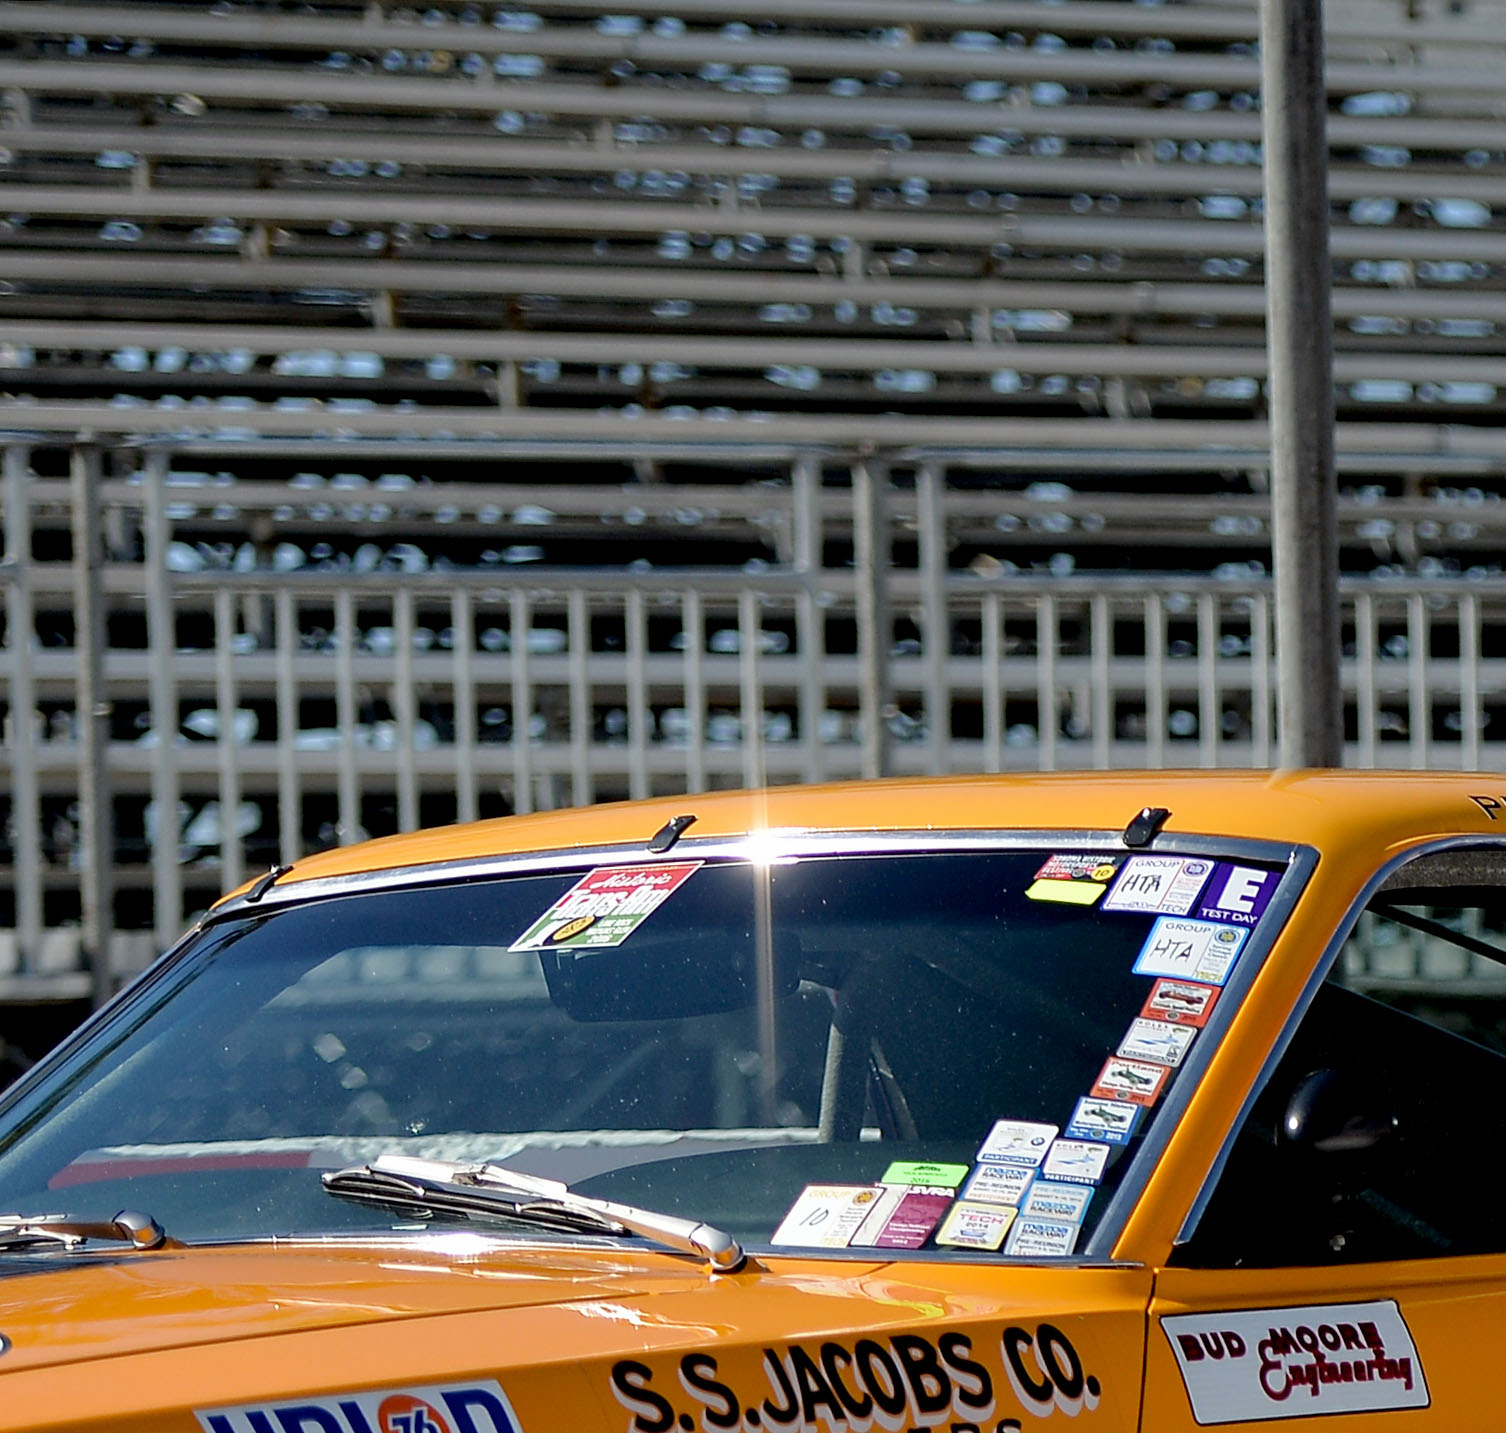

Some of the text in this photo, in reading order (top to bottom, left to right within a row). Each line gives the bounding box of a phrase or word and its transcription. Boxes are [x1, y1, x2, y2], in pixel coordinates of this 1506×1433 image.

[1135, 859, 1181, 869] GROUP
[590, 872, 673, 889] Historic
[1216, 866, 1268, 913] E
[1161, 903, 1188, 914] TECH
[1201, 908, 1258, 925] TEST DAY
[1165, 922, 1211, 934] GROUP
[1045, 1174, 1096, 1185] PARTICIPANT
[960, 1213, 1005, 1225] TECH
[1177, 1321, 1384, 1362] BUD MOORE
[1000, 1323, 1102, 1418] CO.
[1257, 1337, 1415, 1402] Engineering
